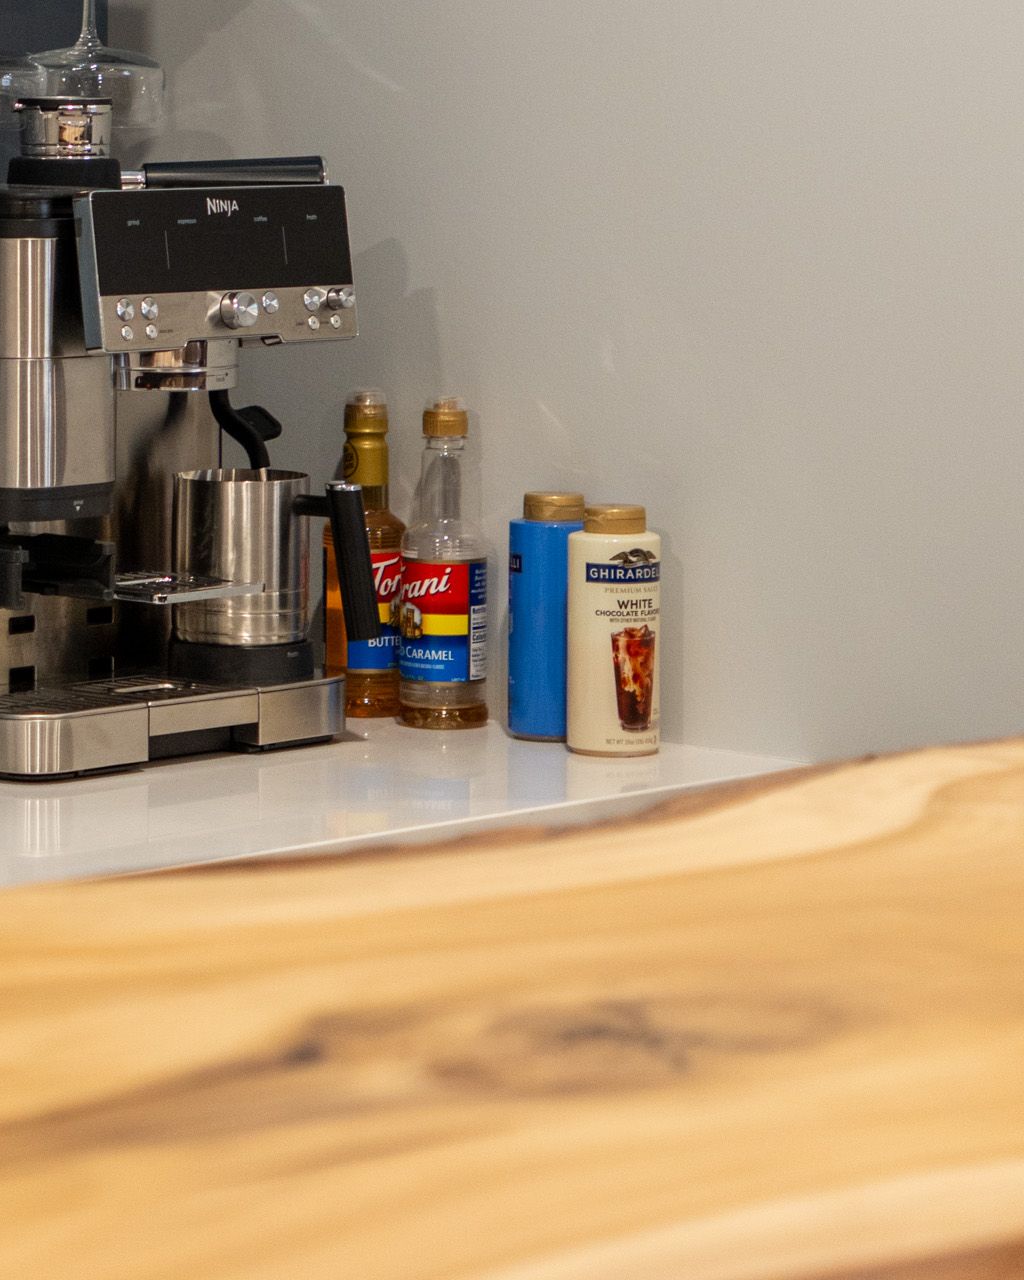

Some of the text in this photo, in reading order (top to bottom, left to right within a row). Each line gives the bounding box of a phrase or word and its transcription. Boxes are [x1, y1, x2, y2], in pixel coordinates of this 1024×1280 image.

[206, 197, 240, 217] NINJA
[617, 599, 652, 610] WHITE
[595, 609, 638, 617] CHOCOLATE
[406, 646, 454, 661] CARAMEL
